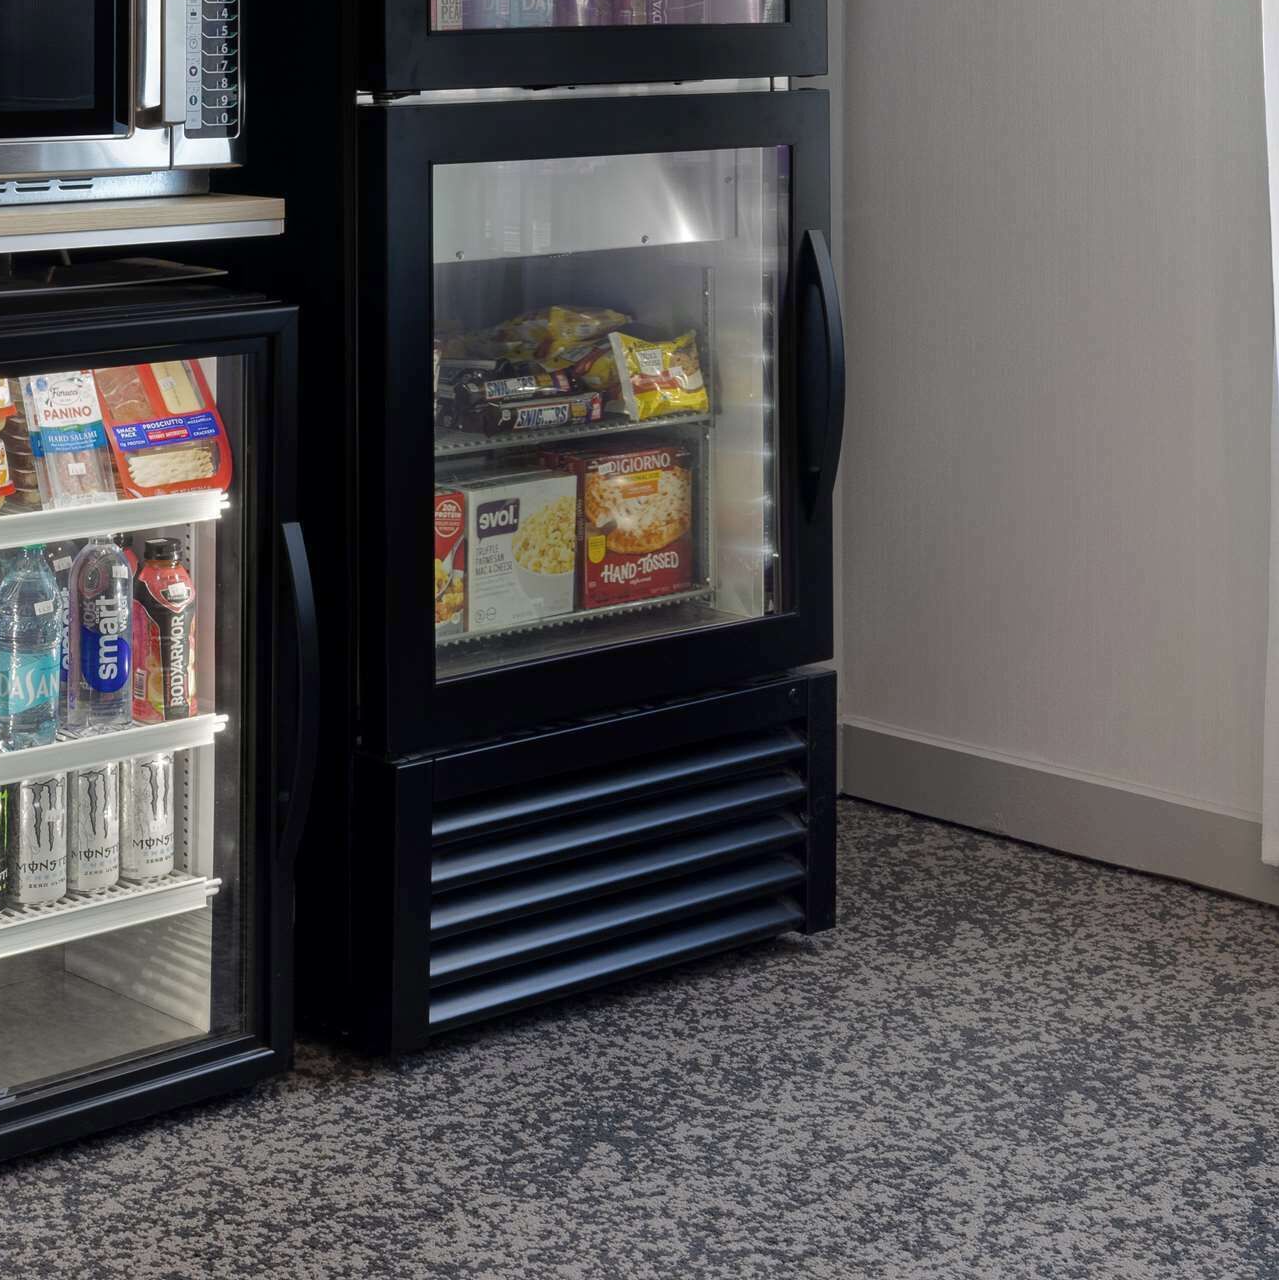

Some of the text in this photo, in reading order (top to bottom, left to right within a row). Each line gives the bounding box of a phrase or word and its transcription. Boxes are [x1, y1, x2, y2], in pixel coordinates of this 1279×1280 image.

[222, 8, 228, 18] 4
[222, 26, 228, 36] 5
[222, 43, 228, 53] 6
[222, 61, 228, 70] 7
[222, 78, 228, 88] 8
[222, 96, 228, 106] 9
[222, 113, 228, 123] 0
[44, 406, 91, 421] PANINO
[143, 419, 183, 429] PROSCIUTTO
[48, 431, 98, 443] HARD SALAMI
[610, 453, 670, 473] DIGIORNO
[602, 552, 679, 584] HAND-TOSSED
[96, 596, 119, 680] smart
[171, 615, 184, 707] BODYARMOR
